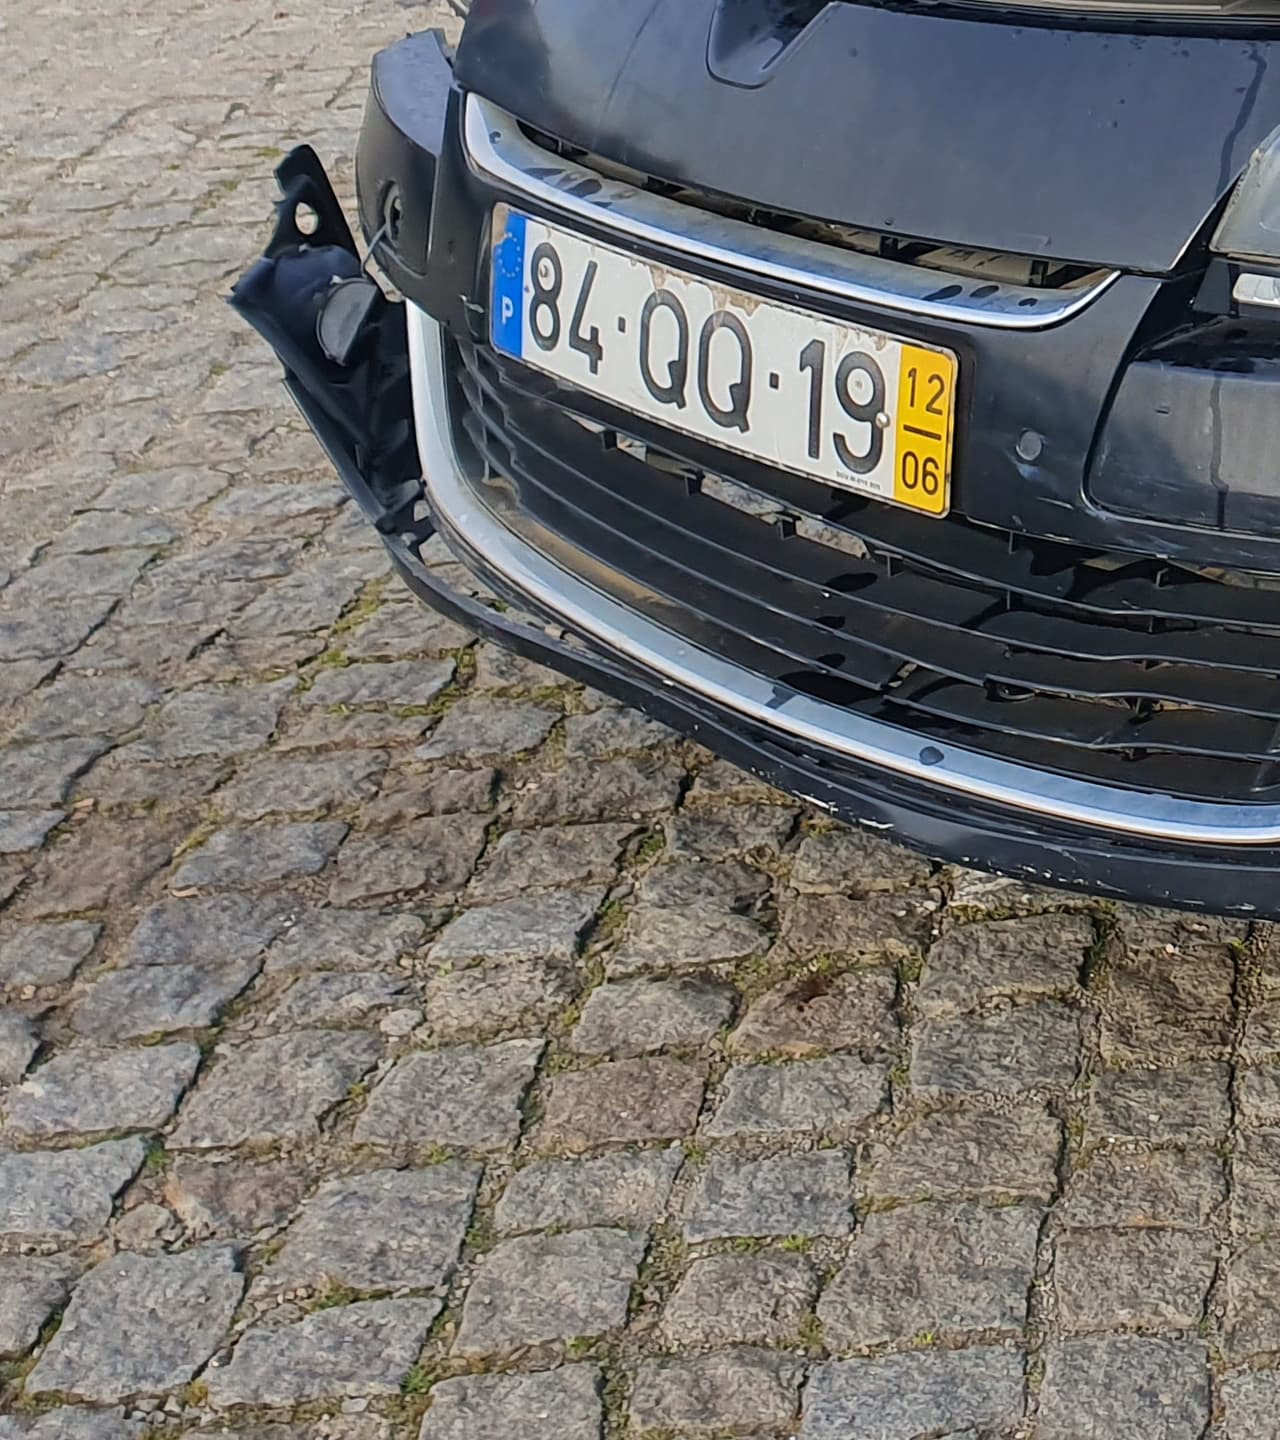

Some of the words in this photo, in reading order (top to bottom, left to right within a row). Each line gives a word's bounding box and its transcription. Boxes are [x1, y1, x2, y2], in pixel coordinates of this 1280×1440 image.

[501, 297, 514, 326] P
[907, 367, 945, 416] 12
[901, 450, 940, 496] 06
